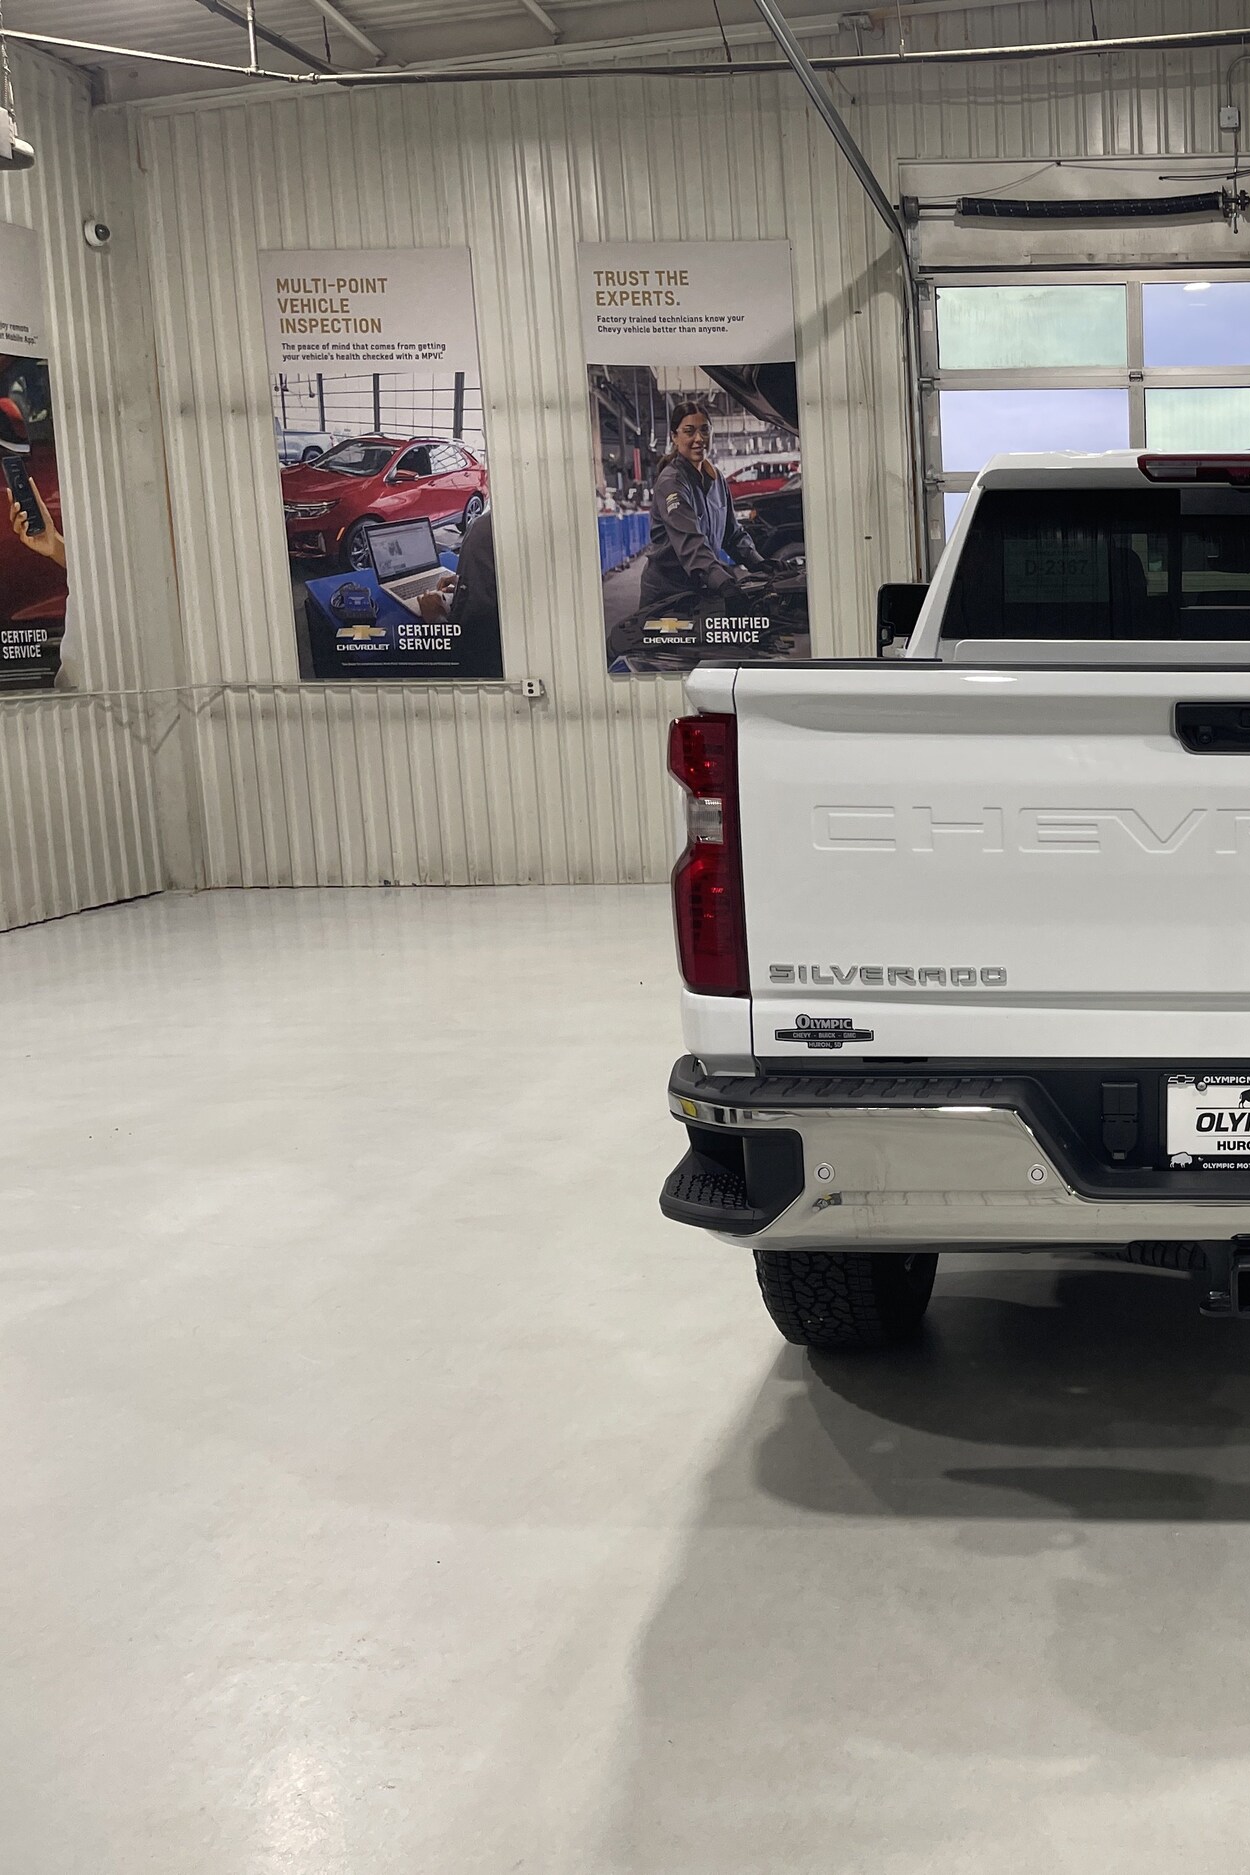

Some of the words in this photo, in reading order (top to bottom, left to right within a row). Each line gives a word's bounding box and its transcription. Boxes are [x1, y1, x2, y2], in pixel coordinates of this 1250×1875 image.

[593, 270, 650, 286] TRUST
[655, 270, 690, 286] THE
[276, 278, 388, 294] MULTI-POINT
[595, 290, 681, 306] EXPERTS.
[277, 298, 350, 314] VEHICLE
[596, 315, 627, 324] Factory
[629, 315, 657, 323] trained
[659, 315, 703, 323] technicians
[726, 315, 745, 323] your
[279, 318, 382, 334] INSPECTION
[597, 325, 621, 334] Chevy
[623, 325, 651, 333] vehicle
[652, 325, 677, 333] better
[678, 325, 697, 333] than
[698, 326, 729, 334] anyone.
[297, 344, 320, 352] peace
[418, 342, 446, 351] getting
[282, 354, 300, 362] your
[301, 352, 334, 360] vehicle's
[395, 352, 413, 360] with
[705, 617, 770, 629] CERTIFIED
[397, 624, 462, 636] CERTIFIED
[0, 629, 48, 644] CERTIFIED
[643, 636, 697, 644] CHEVROLET
[705, 631, 760, 643] SERVICE
[336, 643, 390, 651] CHEVROLET
[398, 638, 452, 650] SERVICE
[2, 645, 42, 659] SERVICE
[769, 964, 1007, 987] SILVERADO
[796, 1014, 852, 1029] OLYMPIC
